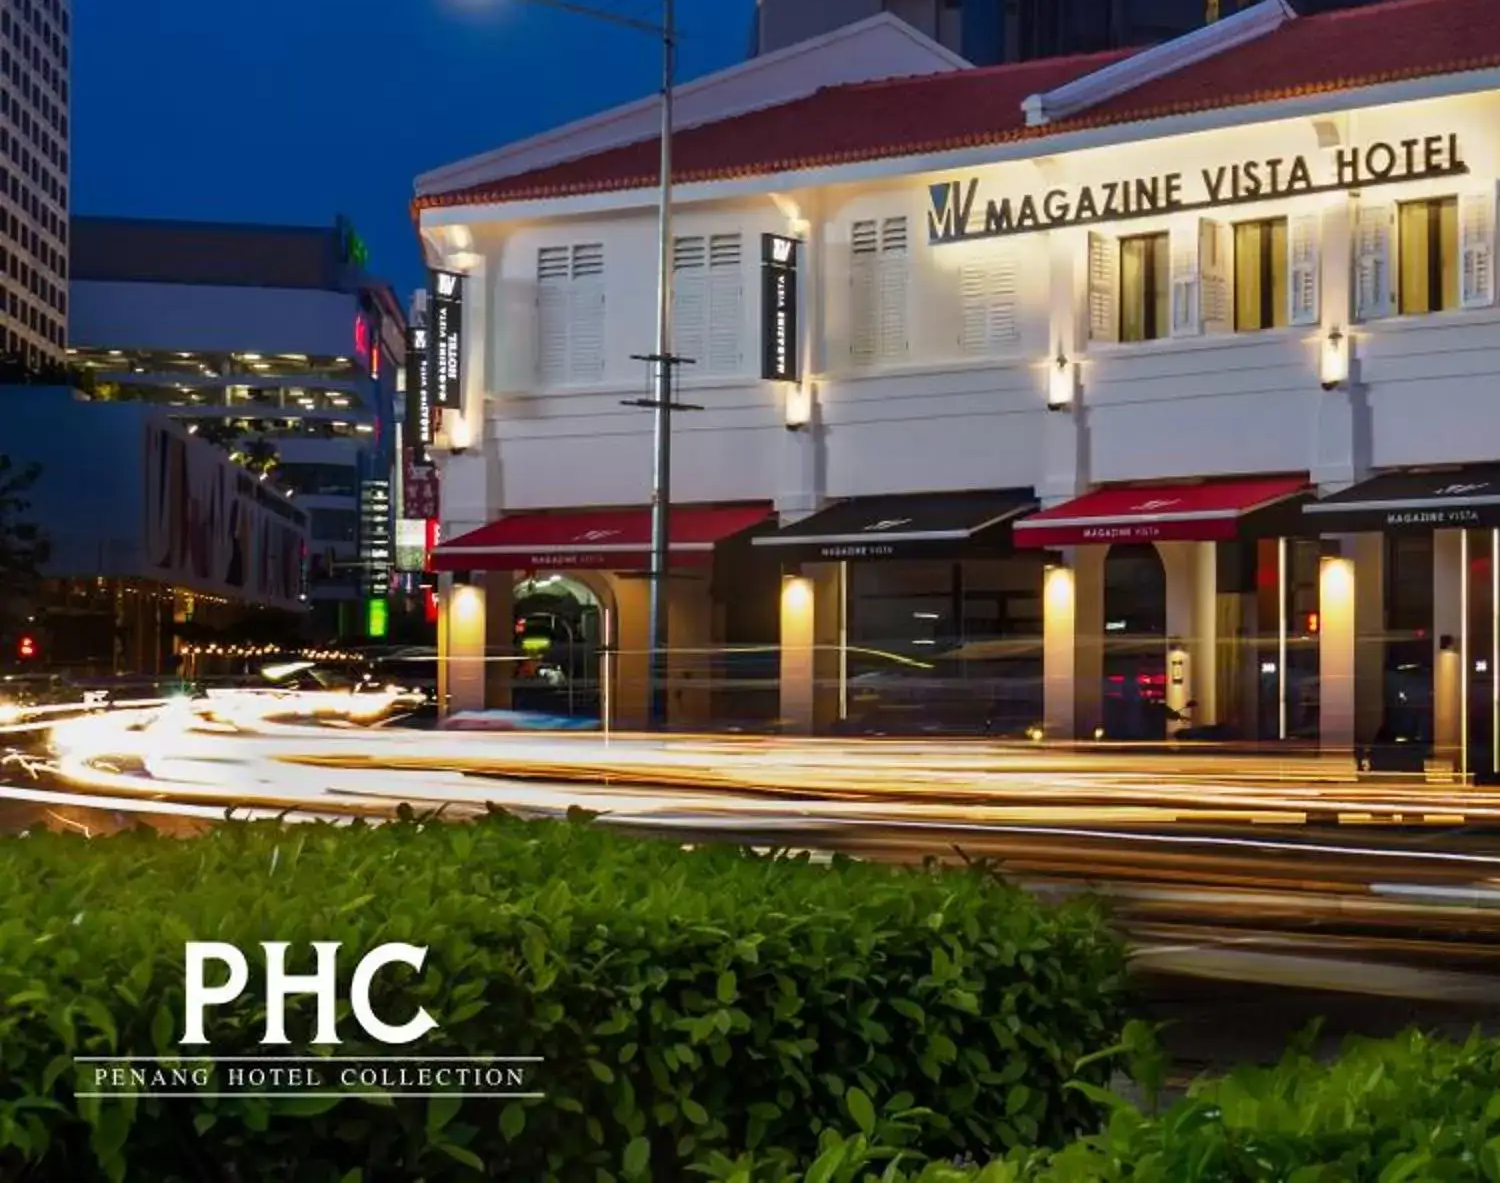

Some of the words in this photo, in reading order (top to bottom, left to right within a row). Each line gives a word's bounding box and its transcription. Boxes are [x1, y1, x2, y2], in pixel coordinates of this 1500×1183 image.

[985, 171, 1183, 232] MAGAZINE
[1200, 154, 1314, 203] VISTA
[1336, 133, 1468, 186] HOTEL
